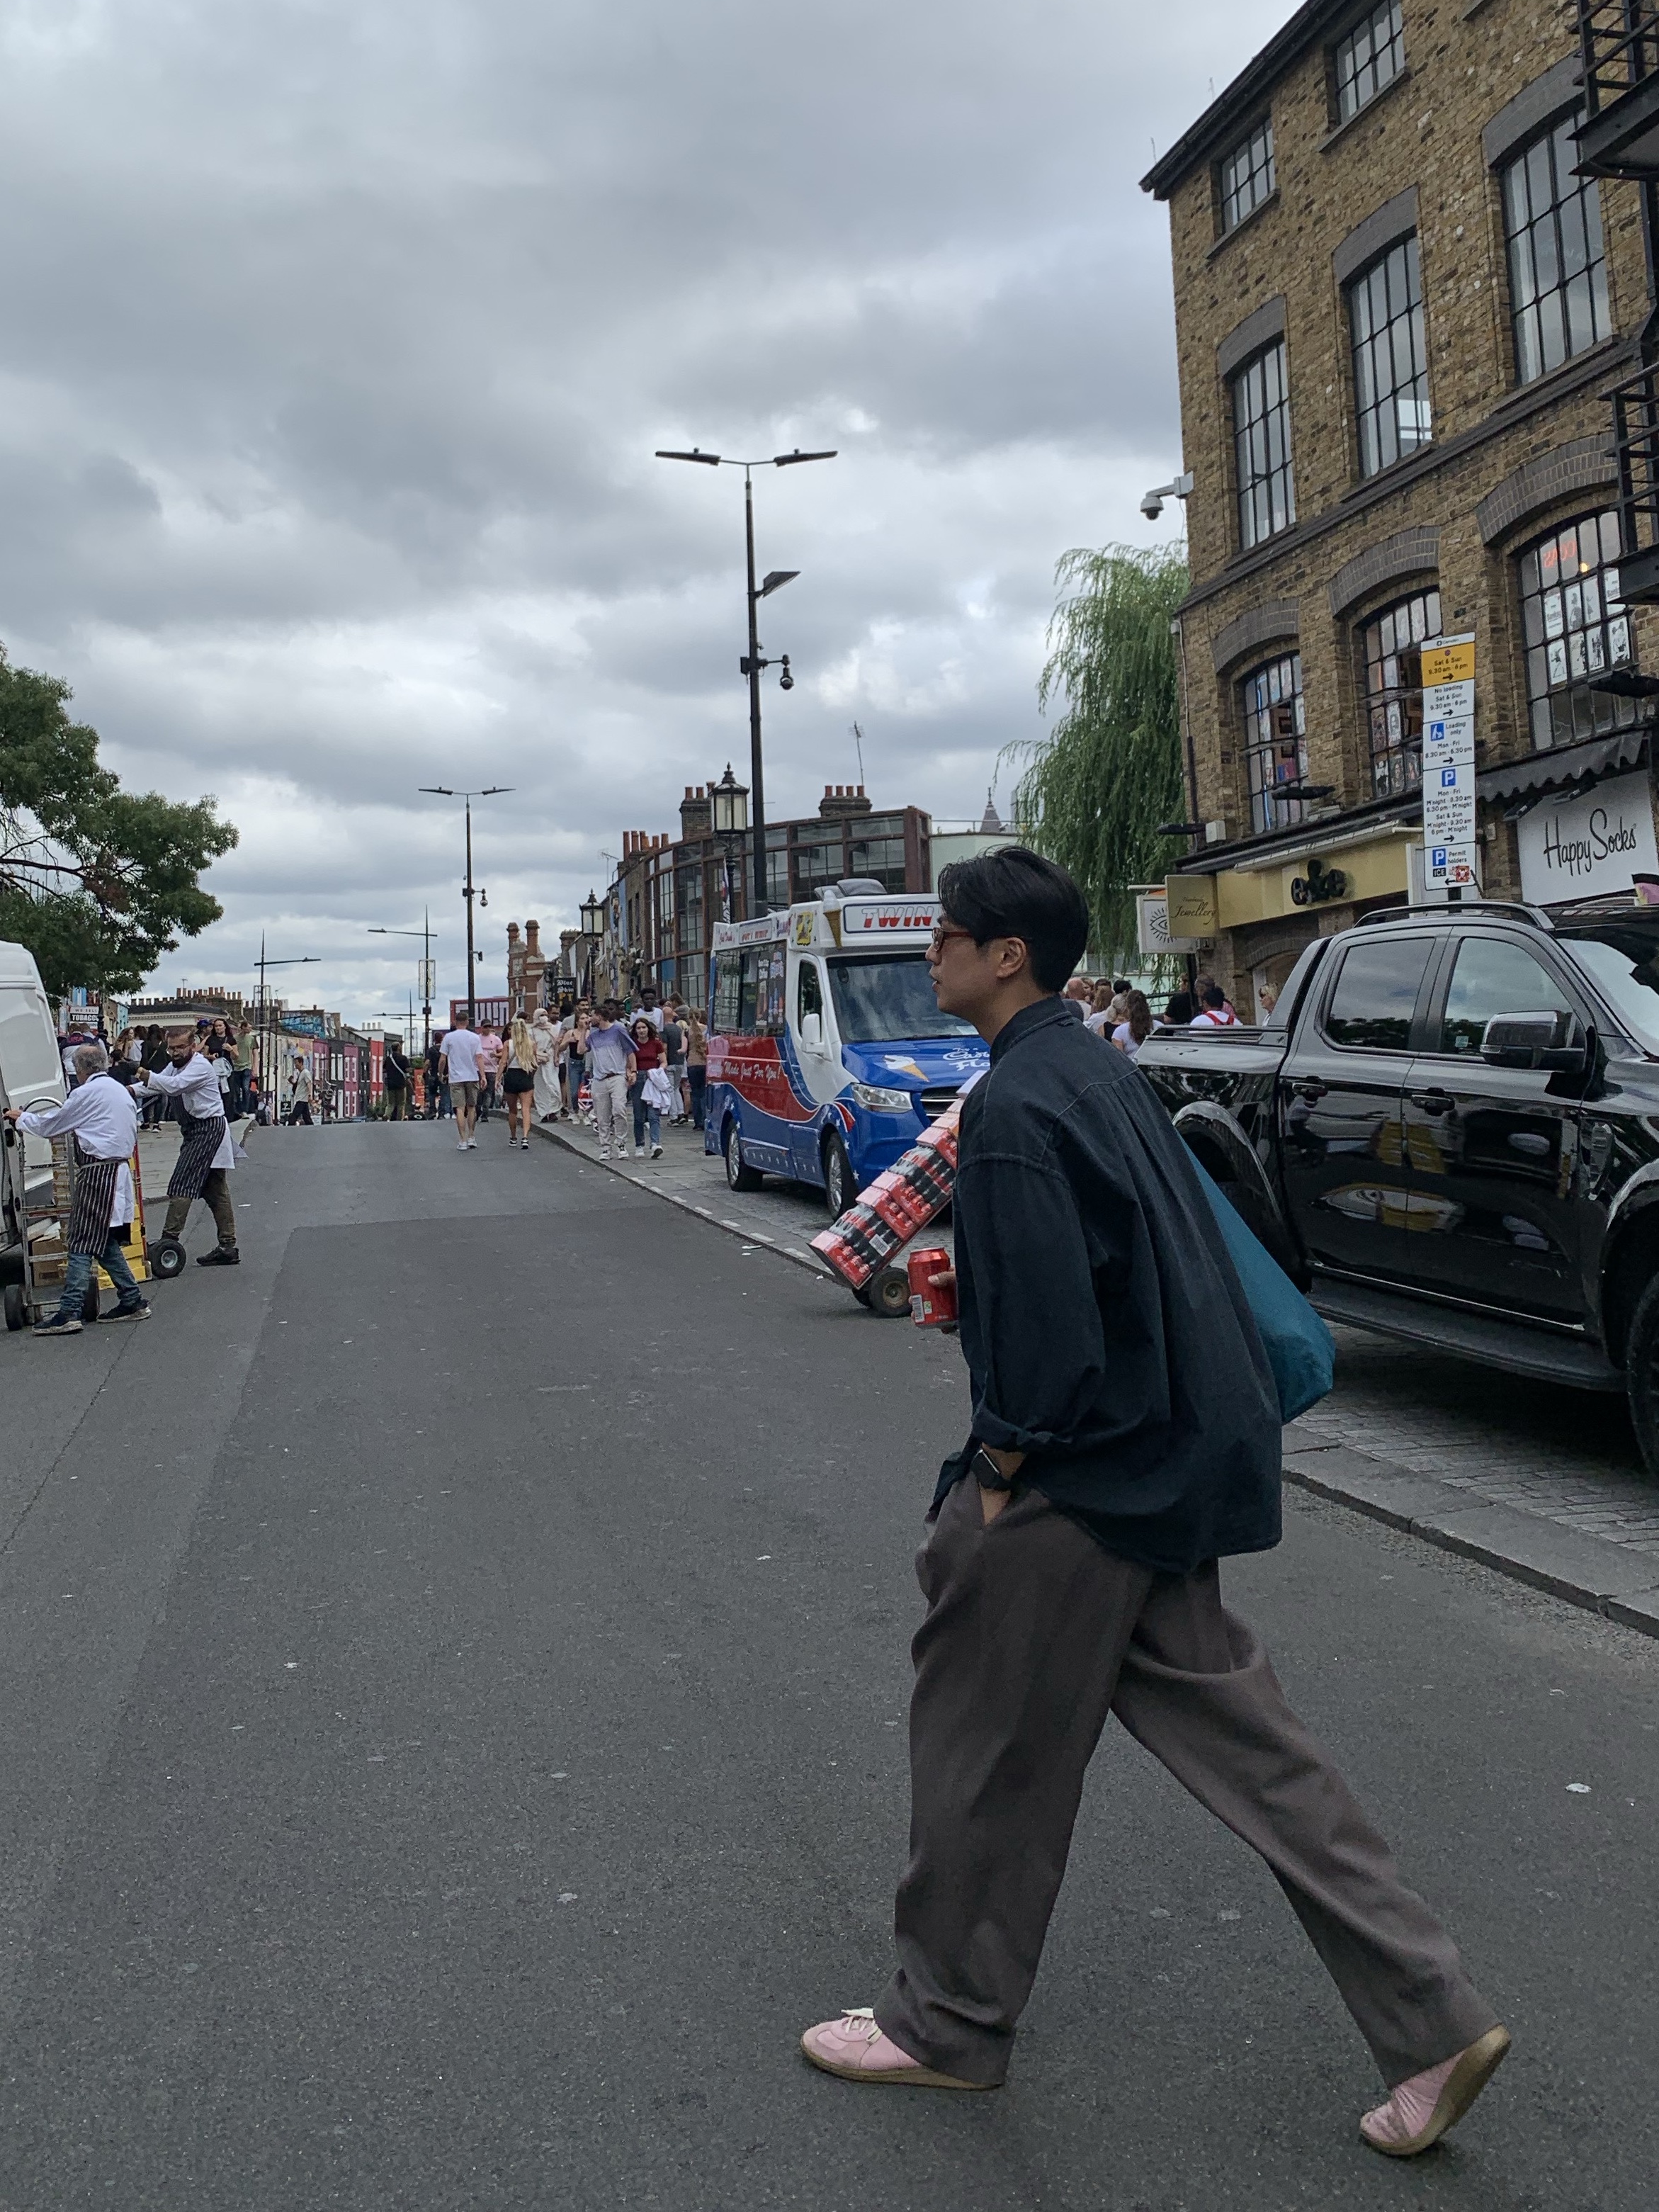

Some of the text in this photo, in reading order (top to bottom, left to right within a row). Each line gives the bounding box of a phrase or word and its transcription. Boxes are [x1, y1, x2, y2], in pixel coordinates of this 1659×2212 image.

[1446, 721, 1466, 730] Loading
[1445, 770, 1454, 786] P
[1543, 808, 1636, 876] Happy Socks
[1435, 850, 1444, 865] P
[861, 906, 934, 928] TWIN
[1170, 901, 1216, 925] Jewellery
[943, 1051, 990, 1061] Cadb
[724, 1061, 739, 1075] Made
[740, 1062, 752, 1082] Just
